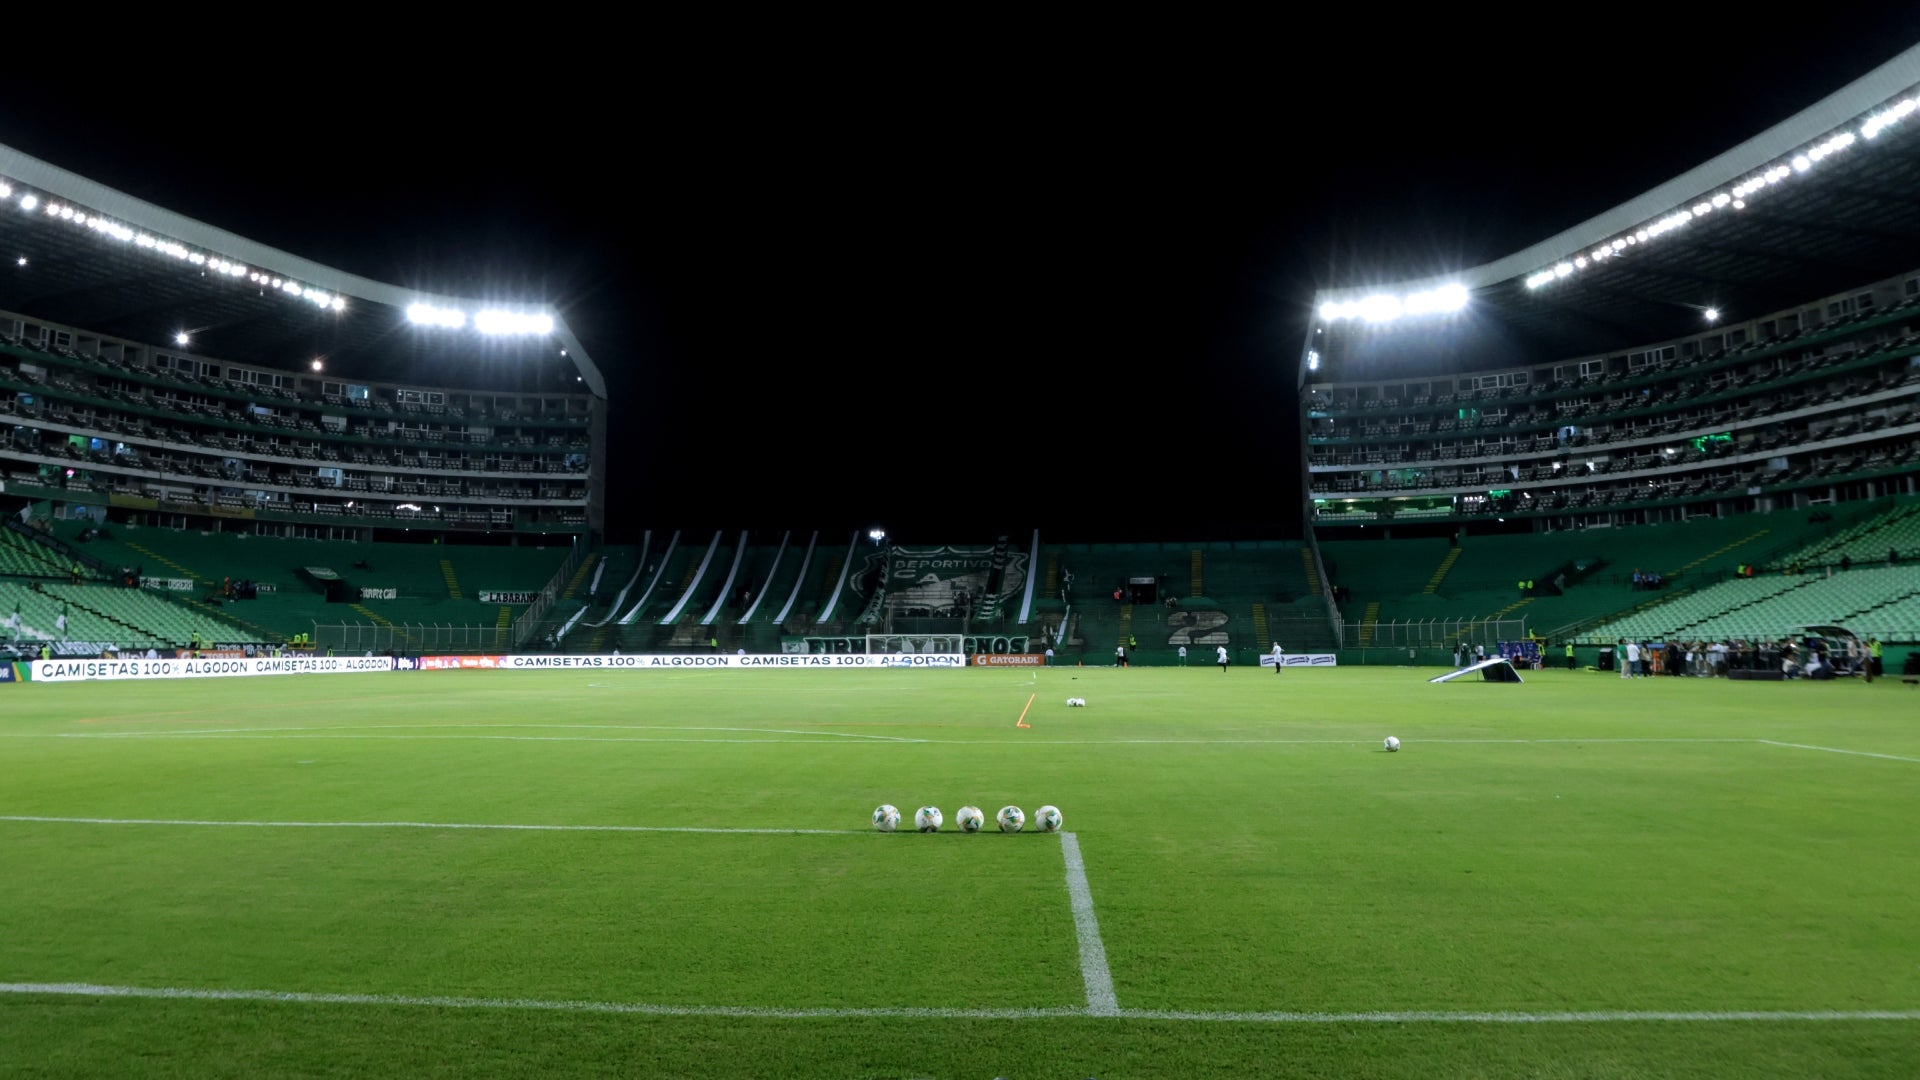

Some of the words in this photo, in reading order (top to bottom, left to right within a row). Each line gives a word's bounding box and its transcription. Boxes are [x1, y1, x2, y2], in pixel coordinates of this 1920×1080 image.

[895, 559, 993, 569] DEPORTIVO
[514, 657, 603, 666] CAMISETAS
[607, 657, 645, 666] 100%
[651, 657, 729, 666] ALGODON
[740, 656, 831, 665] CAMISETAS
[836, 656, 875, 665] 100%
[881, 656, 960, 665] ALGODON
[42, 662, 139, 677] CAMISETAS
[185, 661, 248, 674] ALGODON
[256, 659, 317, 672] CAMISETAS
[346, 658, 389, 669] ALGODON
